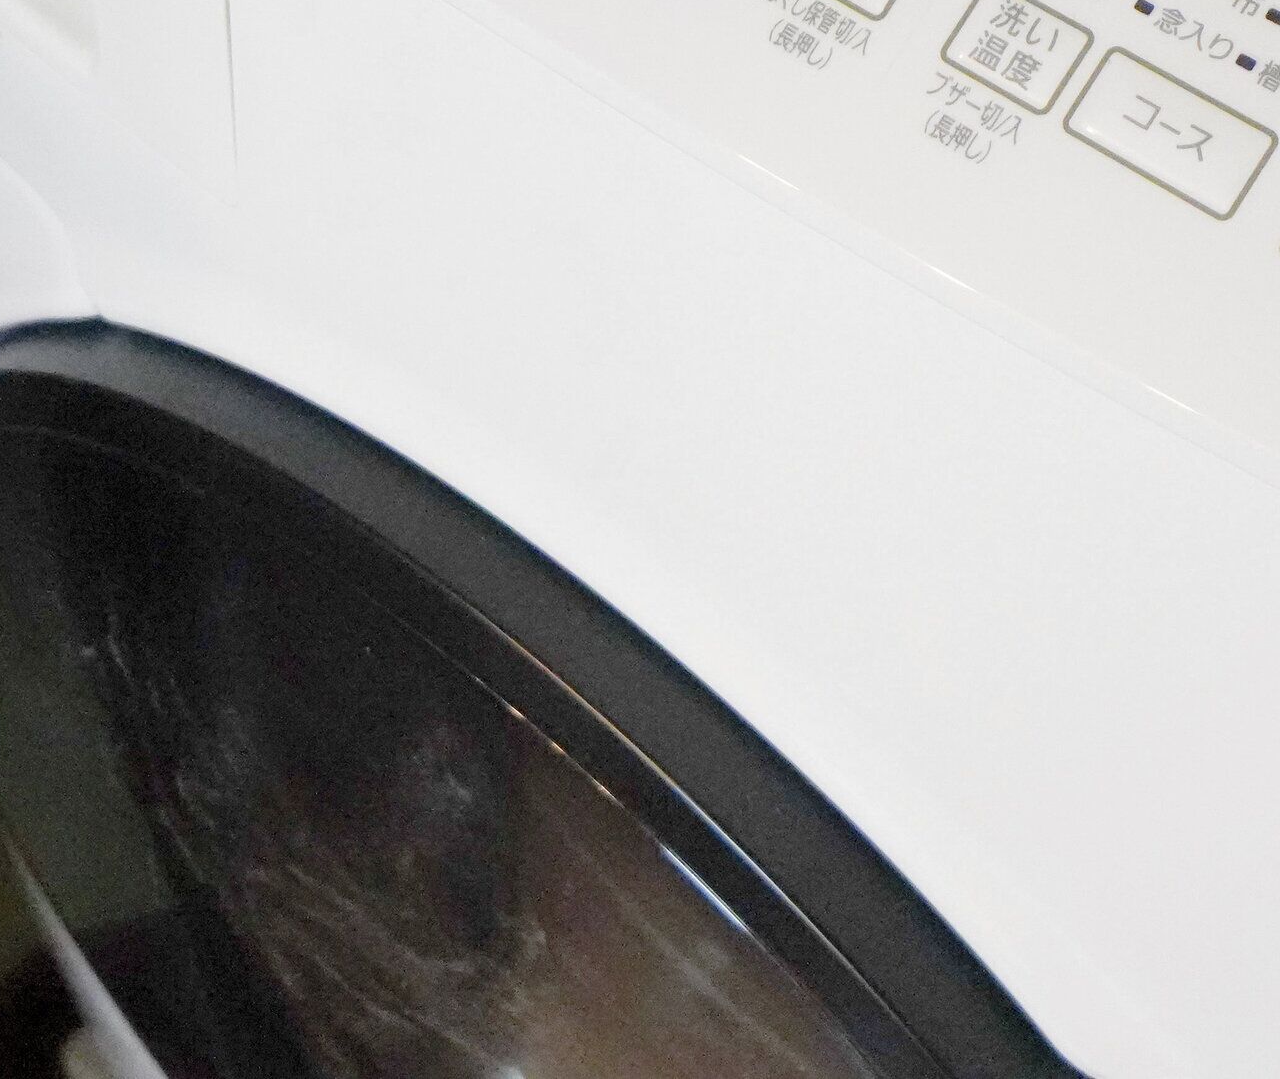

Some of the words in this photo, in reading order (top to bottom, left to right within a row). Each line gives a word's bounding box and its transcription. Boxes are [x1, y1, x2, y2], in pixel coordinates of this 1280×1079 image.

[968, 30, 1043, 91] 温度
[1153, 7, 1234, 61] 念入り
[1123, 94, 1214, 162] コース
